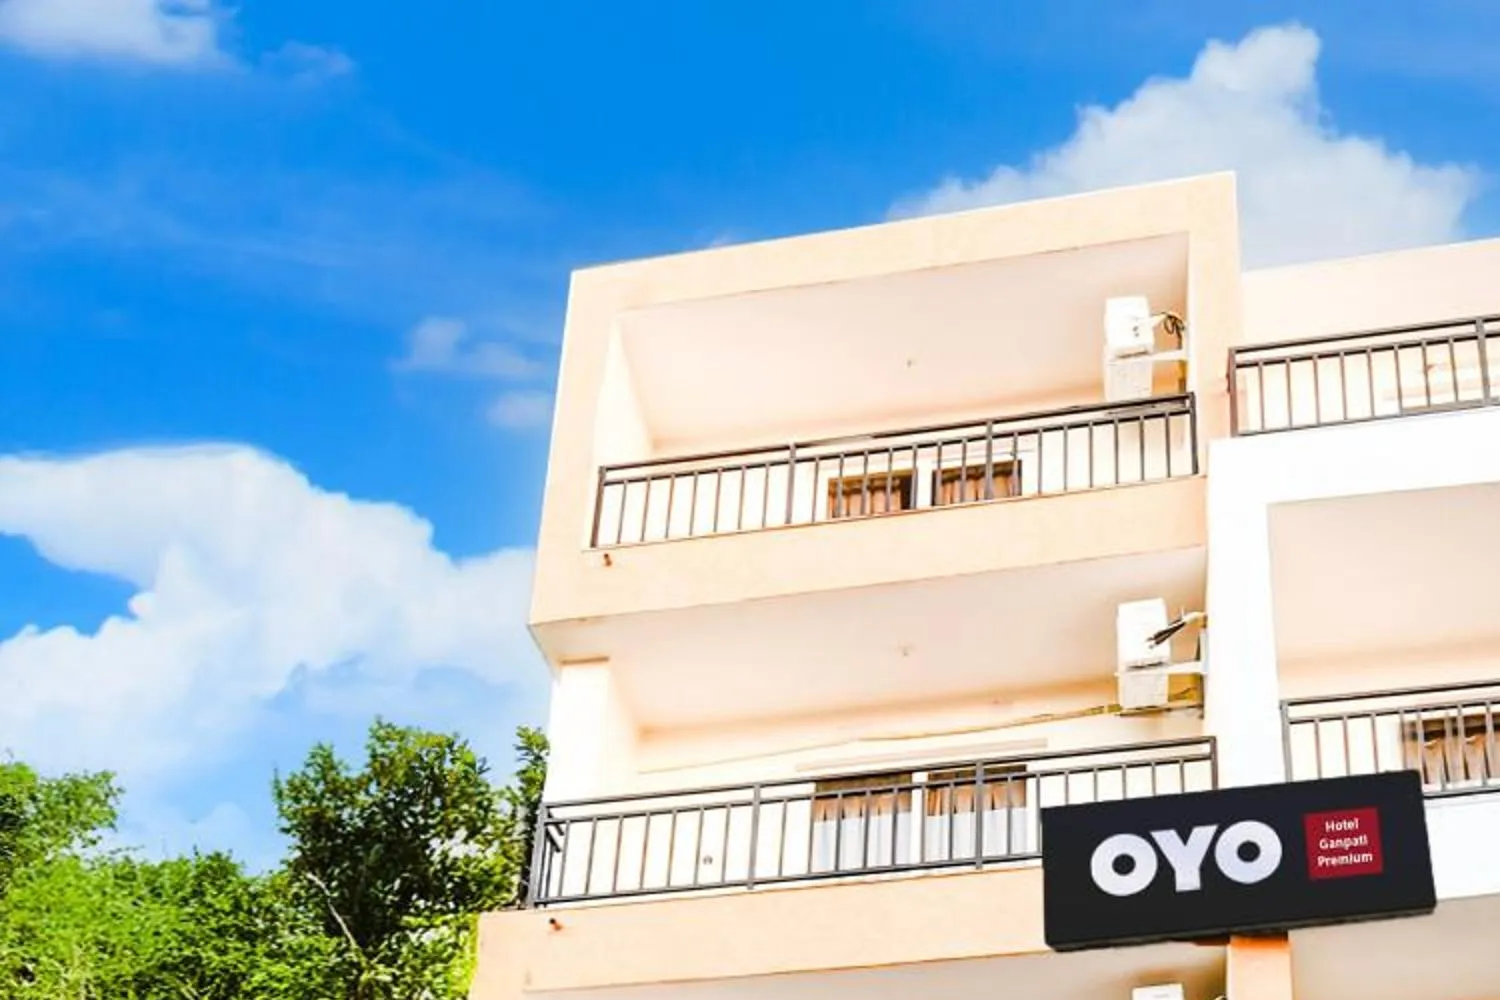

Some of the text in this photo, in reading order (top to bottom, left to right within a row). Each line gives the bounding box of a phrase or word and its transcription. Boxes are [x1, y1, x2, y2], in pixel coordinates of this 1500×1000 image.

[1325, 817, 1359, 832] Hotel
[1319, 834, 1369, 850] Ganpati
[1090, 820, 1282, 896] OYO
[1317, 851, 1373, 867] Premium
